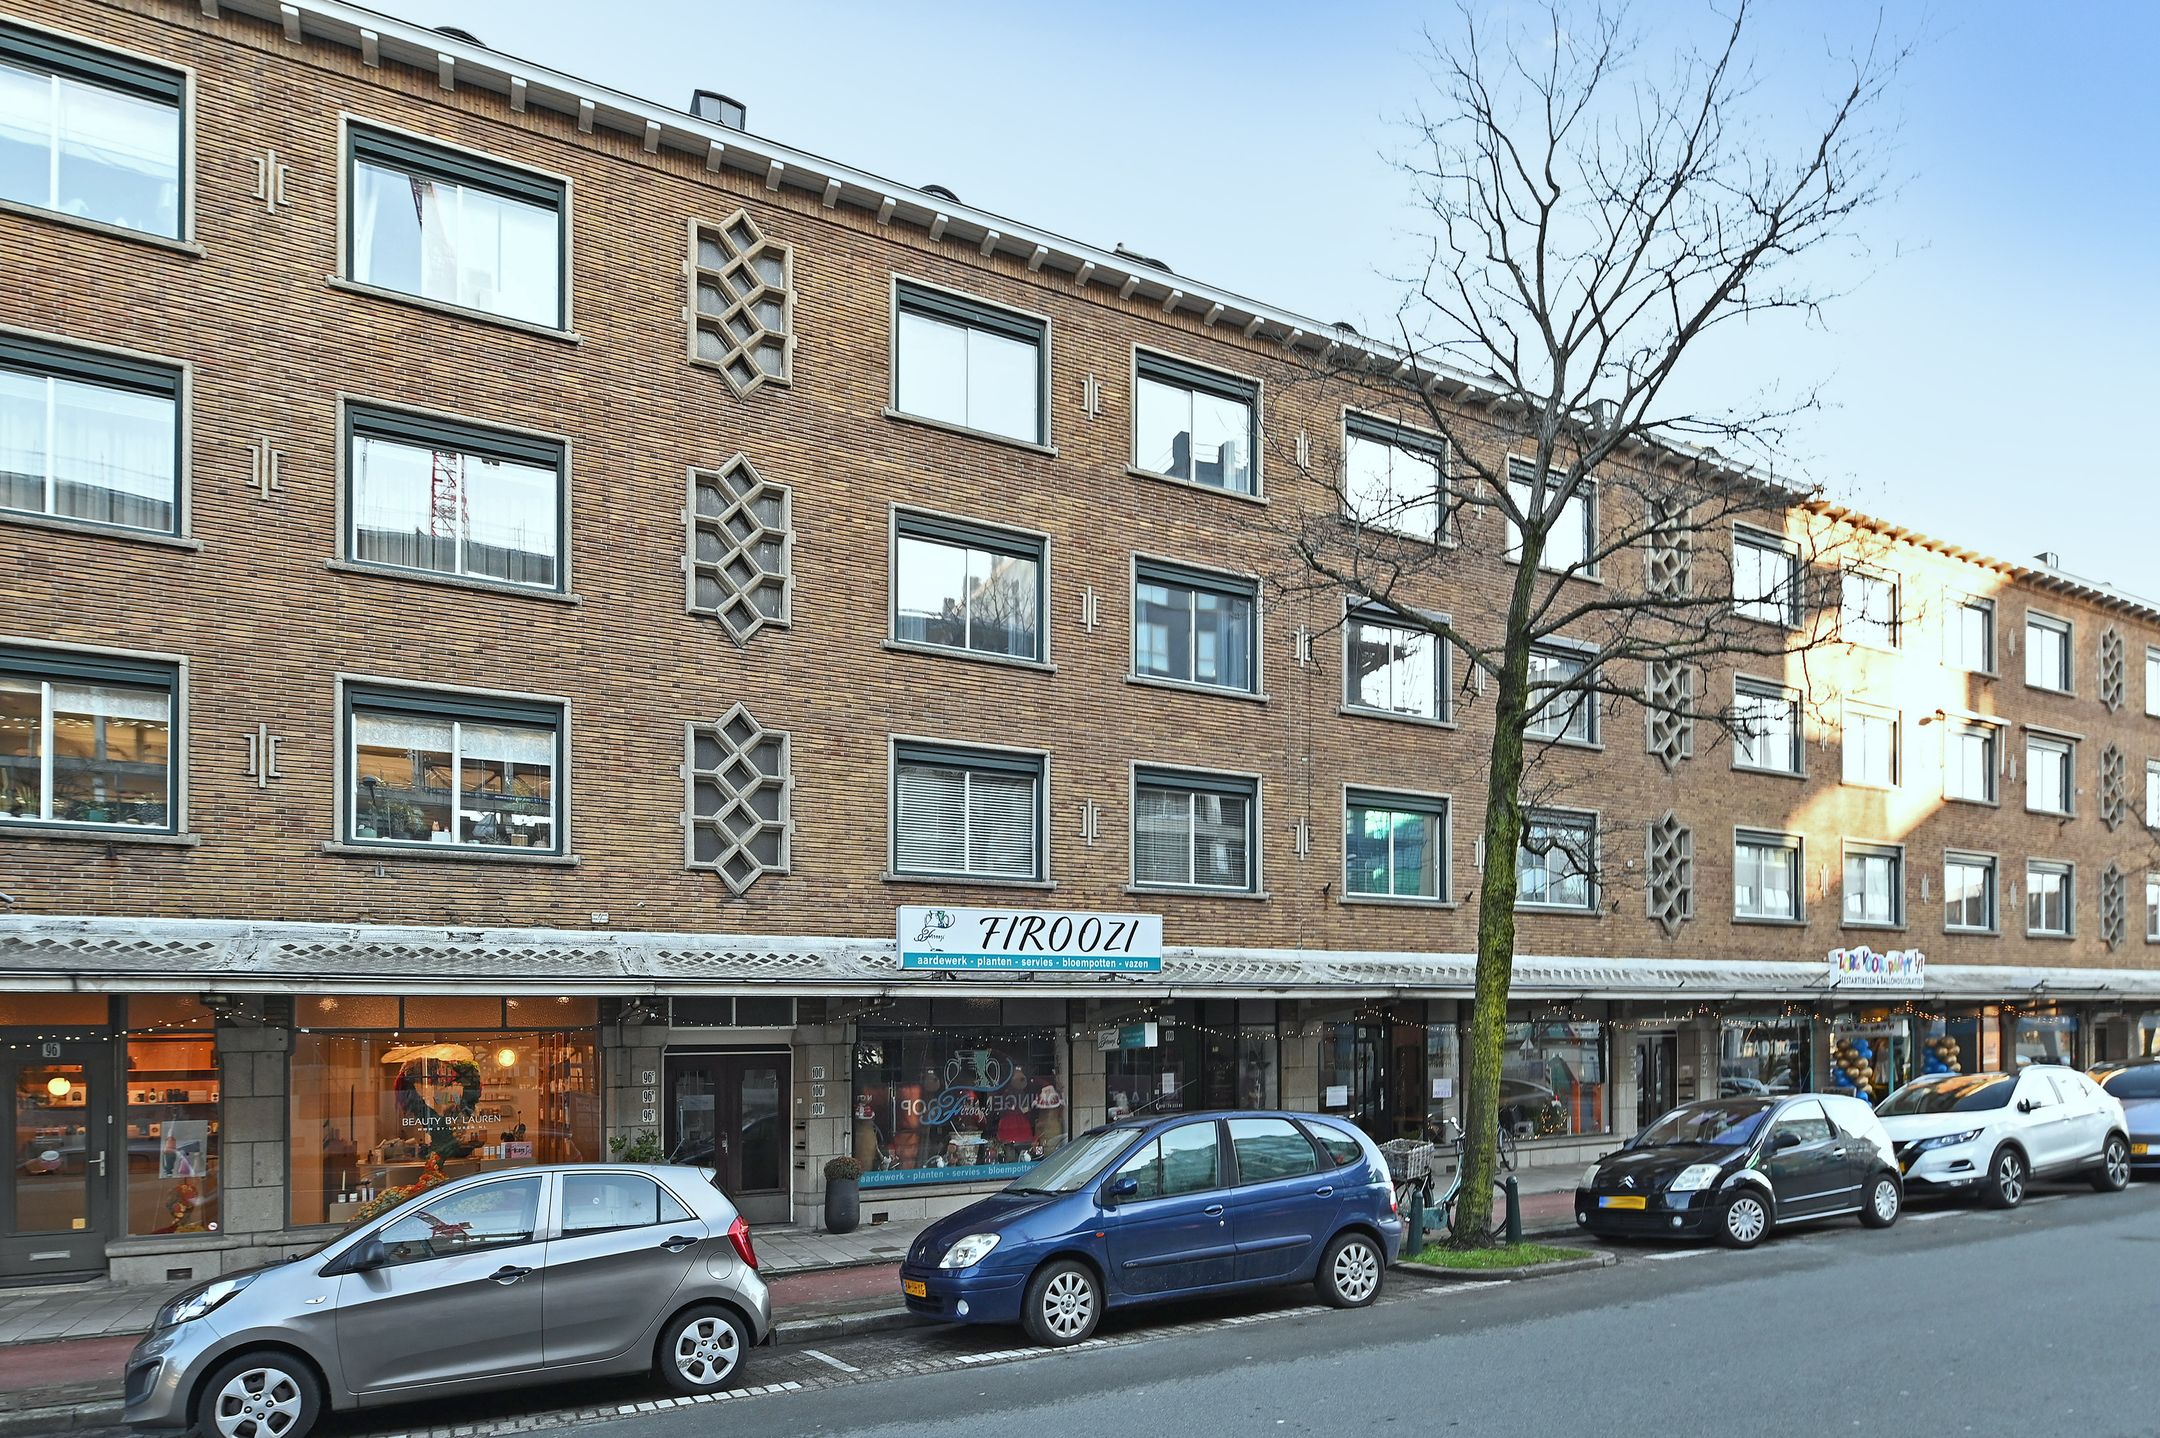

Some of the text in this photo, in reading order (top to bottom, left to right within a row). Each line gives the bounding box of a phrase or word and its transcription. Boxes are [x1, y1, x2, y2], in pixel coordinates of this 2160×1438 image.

[979, 915, 1139, 953] FIROOZI
[917, 955, 967, 965] aardewerk
[977, 956, 1012, 967] planten
[1021, 957, 1053, 967] servies
[1062, 958, 1116, 969] bloempotten
[1124, 960, 1149, 968] vazen
[45, 1043, 58, 1056] 96
[402, 1114, 502, 1127] BEAUTY BY LAUREN
[861, 1172, 904, 1183] aardewerk
[913, 1170, 944, 1182] planten
[952, 1168, 981, 1177] servies
